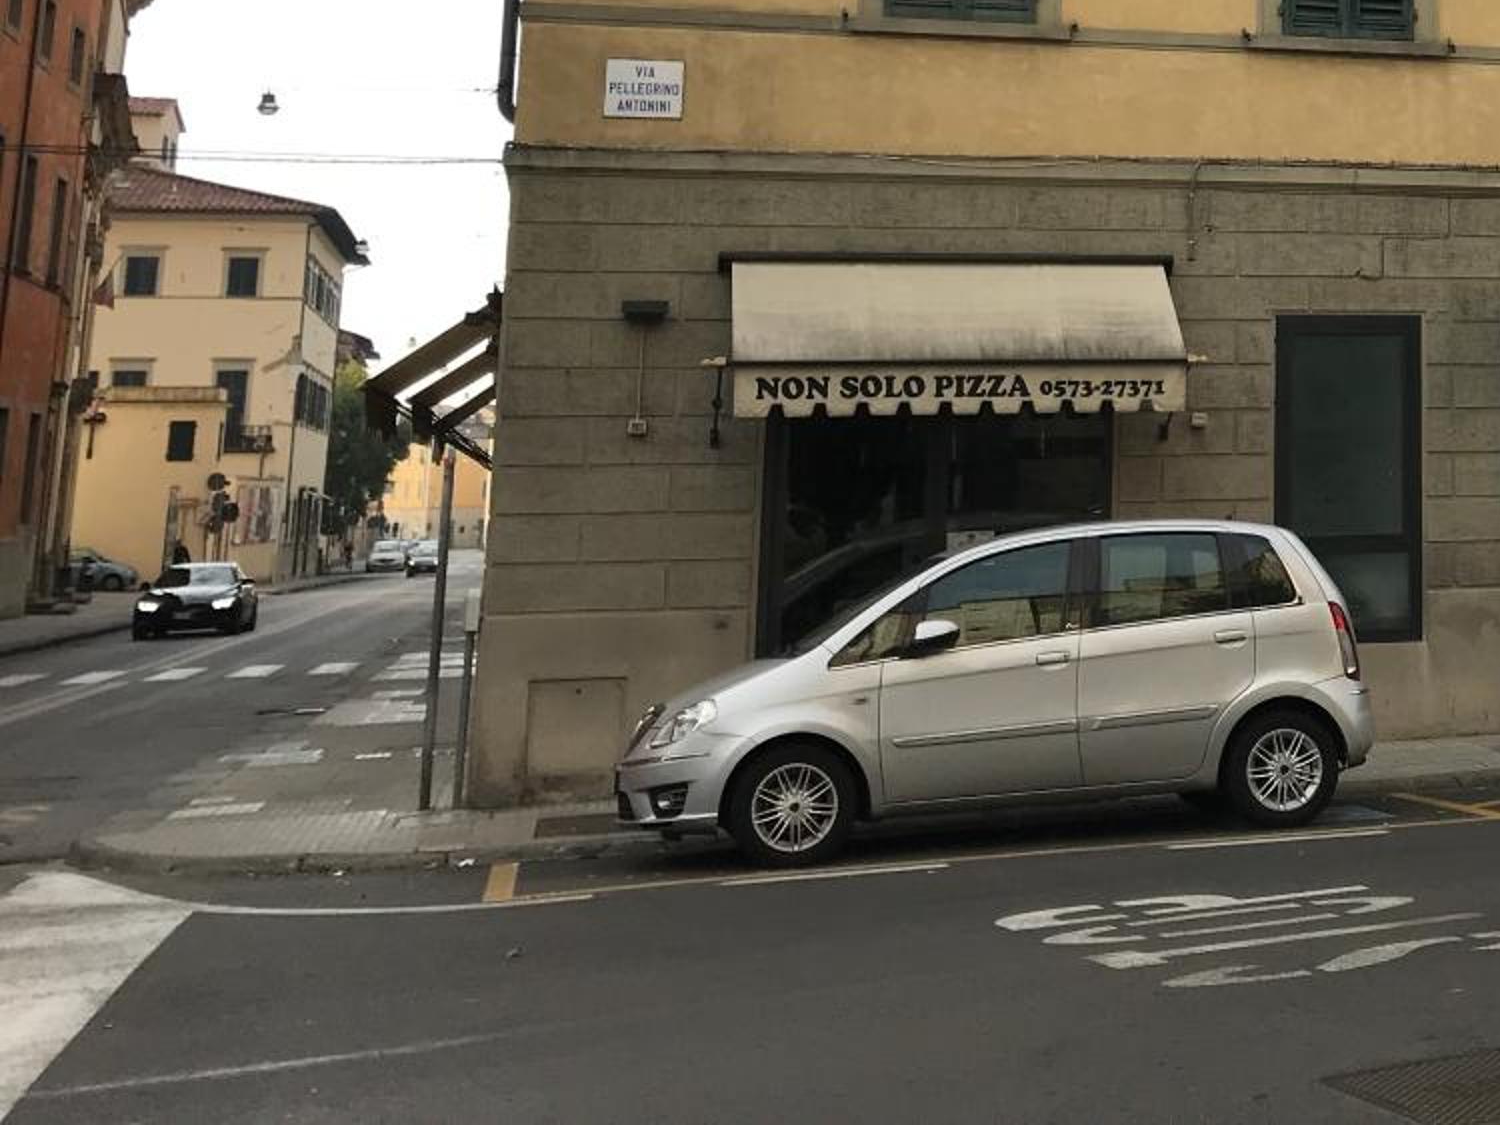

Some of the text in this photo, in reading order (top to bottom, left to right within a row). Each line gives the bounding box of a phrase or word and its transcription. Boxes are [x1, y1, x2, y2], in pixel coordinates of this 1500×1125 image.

[635, 66, 656, 78] VIA
[608, 82, 680, 96] PELLEGRINO
[616, 99, 672, 113] ANTONINI
[755, 374, 1166, 400] NON SOLO PIZZA 0573-27371
